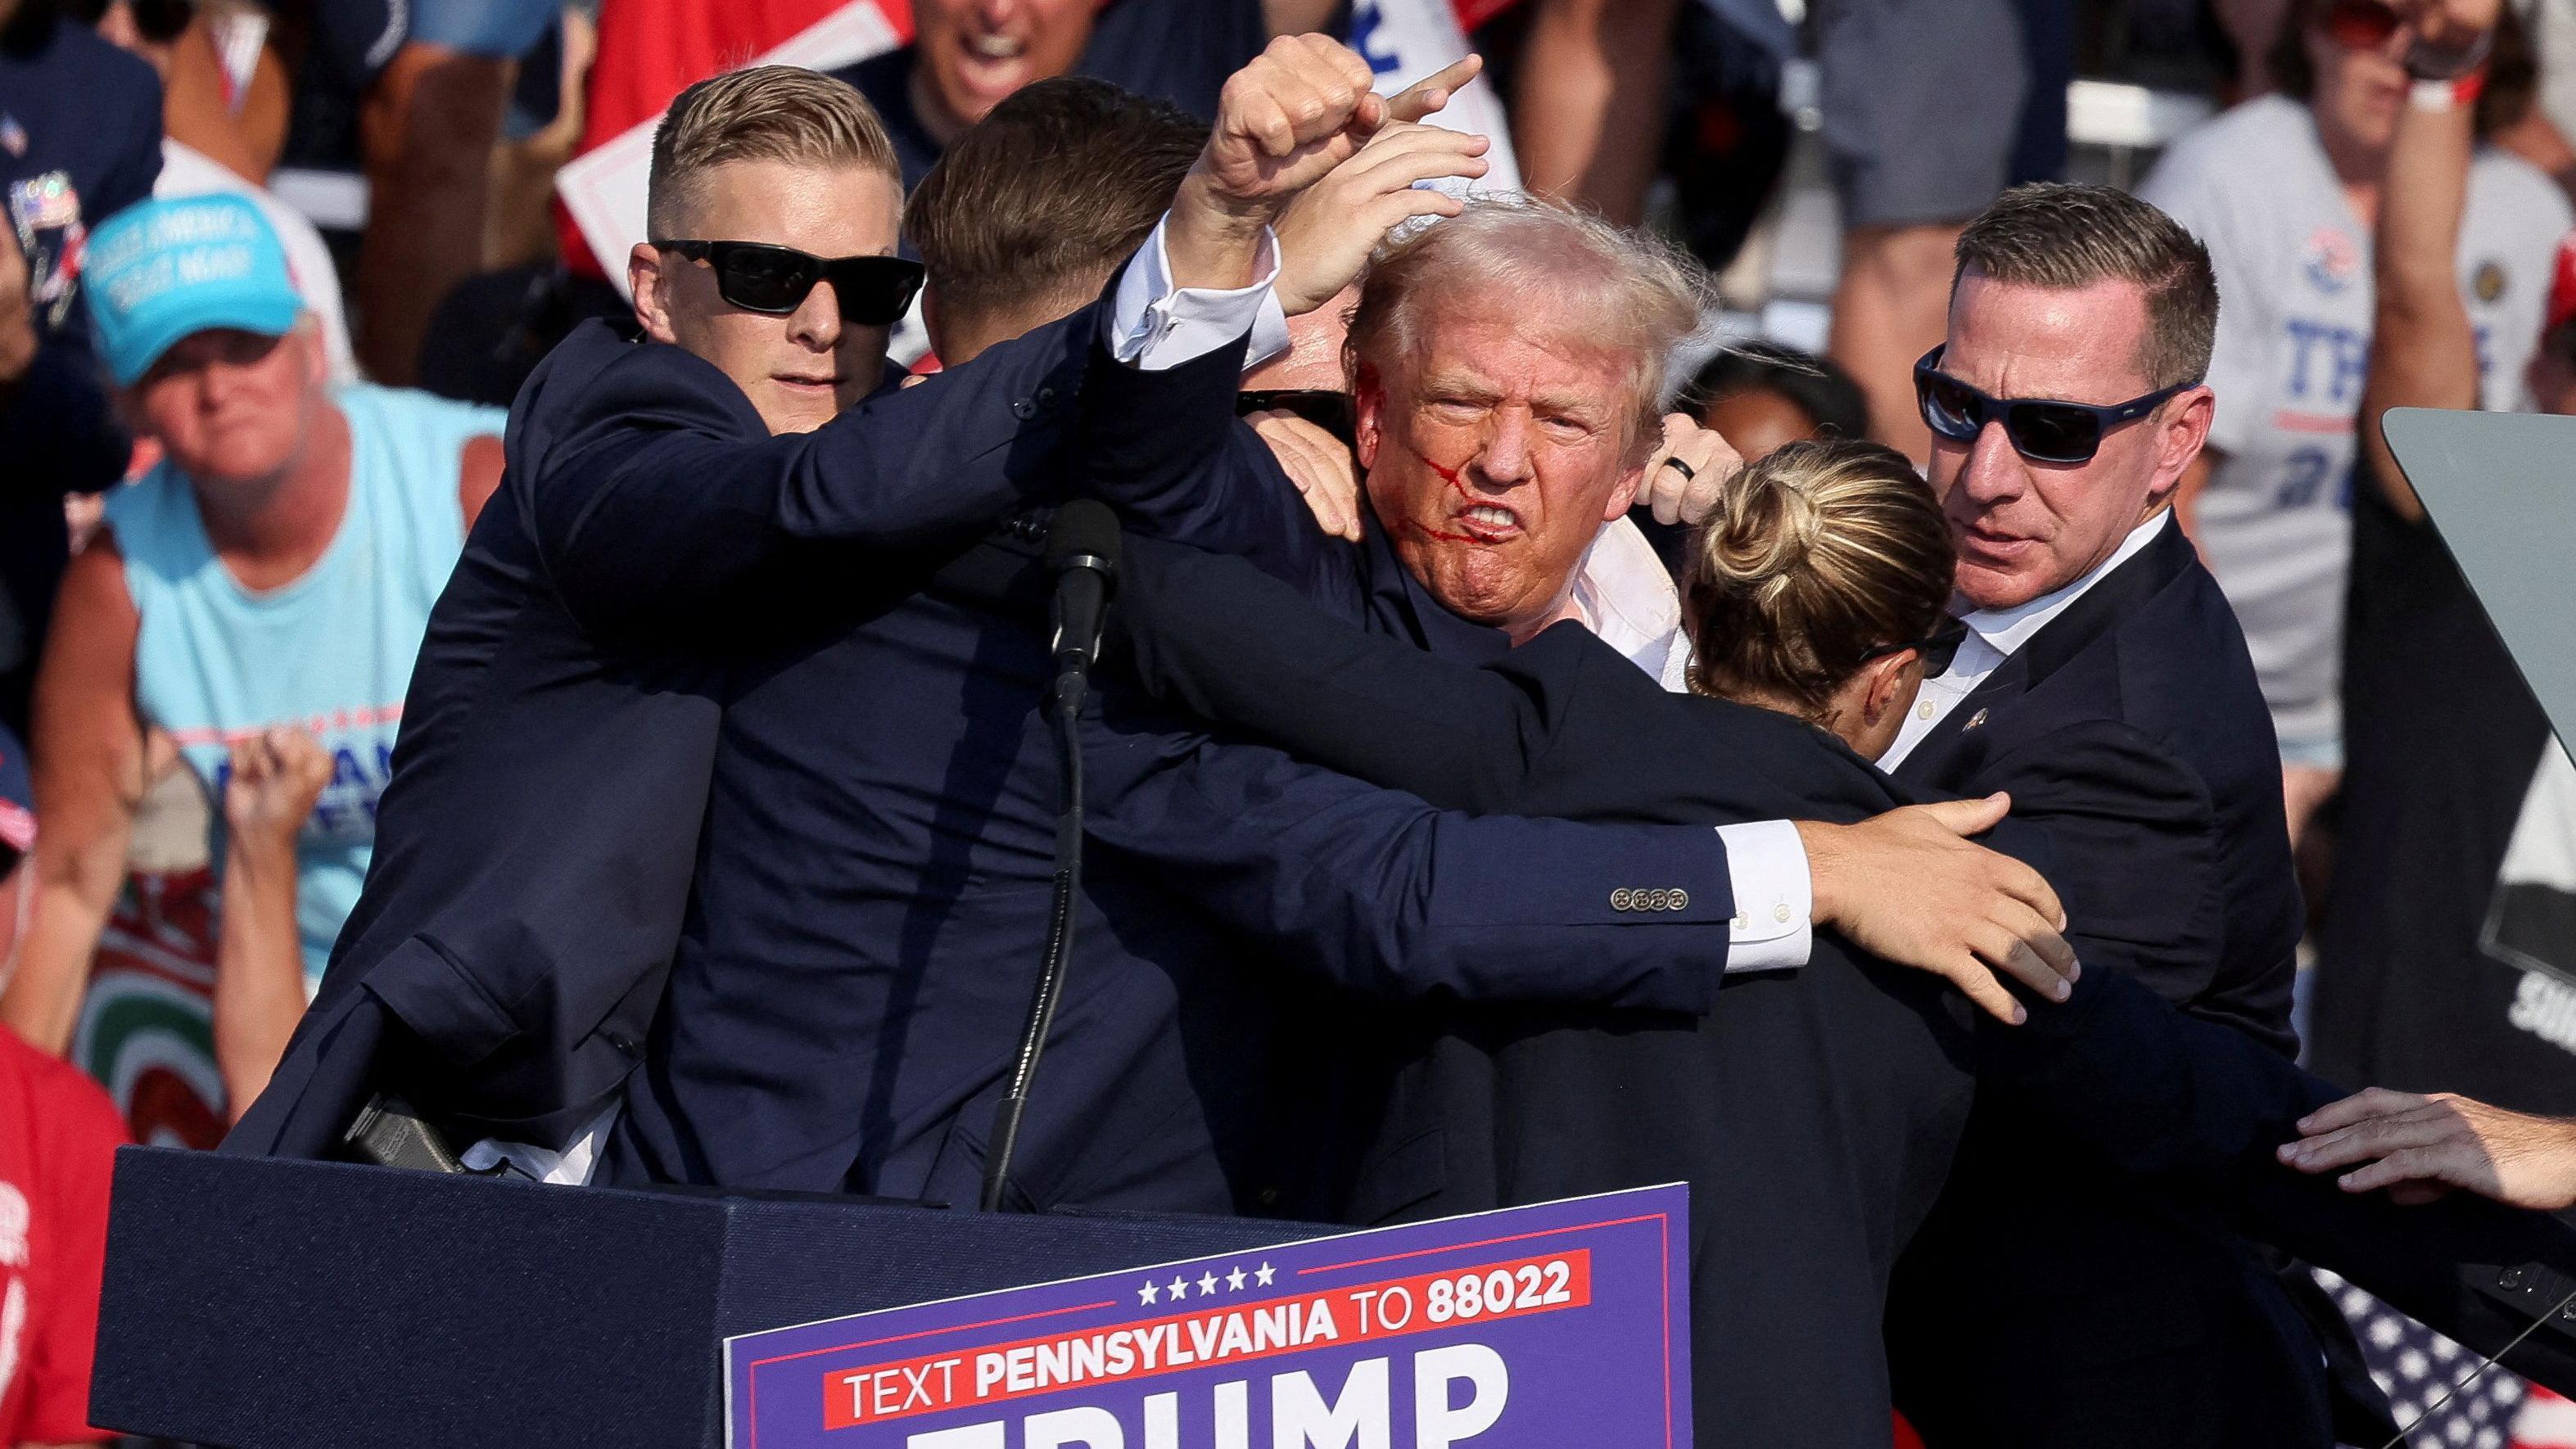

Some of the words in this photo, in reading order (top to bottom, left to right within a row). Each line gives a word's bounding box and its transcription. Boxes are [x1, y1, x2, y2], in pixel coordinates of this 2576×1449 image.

[843, 1358, 962, 1420] TEXT
[975, 1298, 1339, 1398] PENNSYLVANIA
[1349, 1286, 1413, 1335] TO
[1426, 1259, 1571, 1324] 88022
[906, 1343, 1509, 1449] UMP
